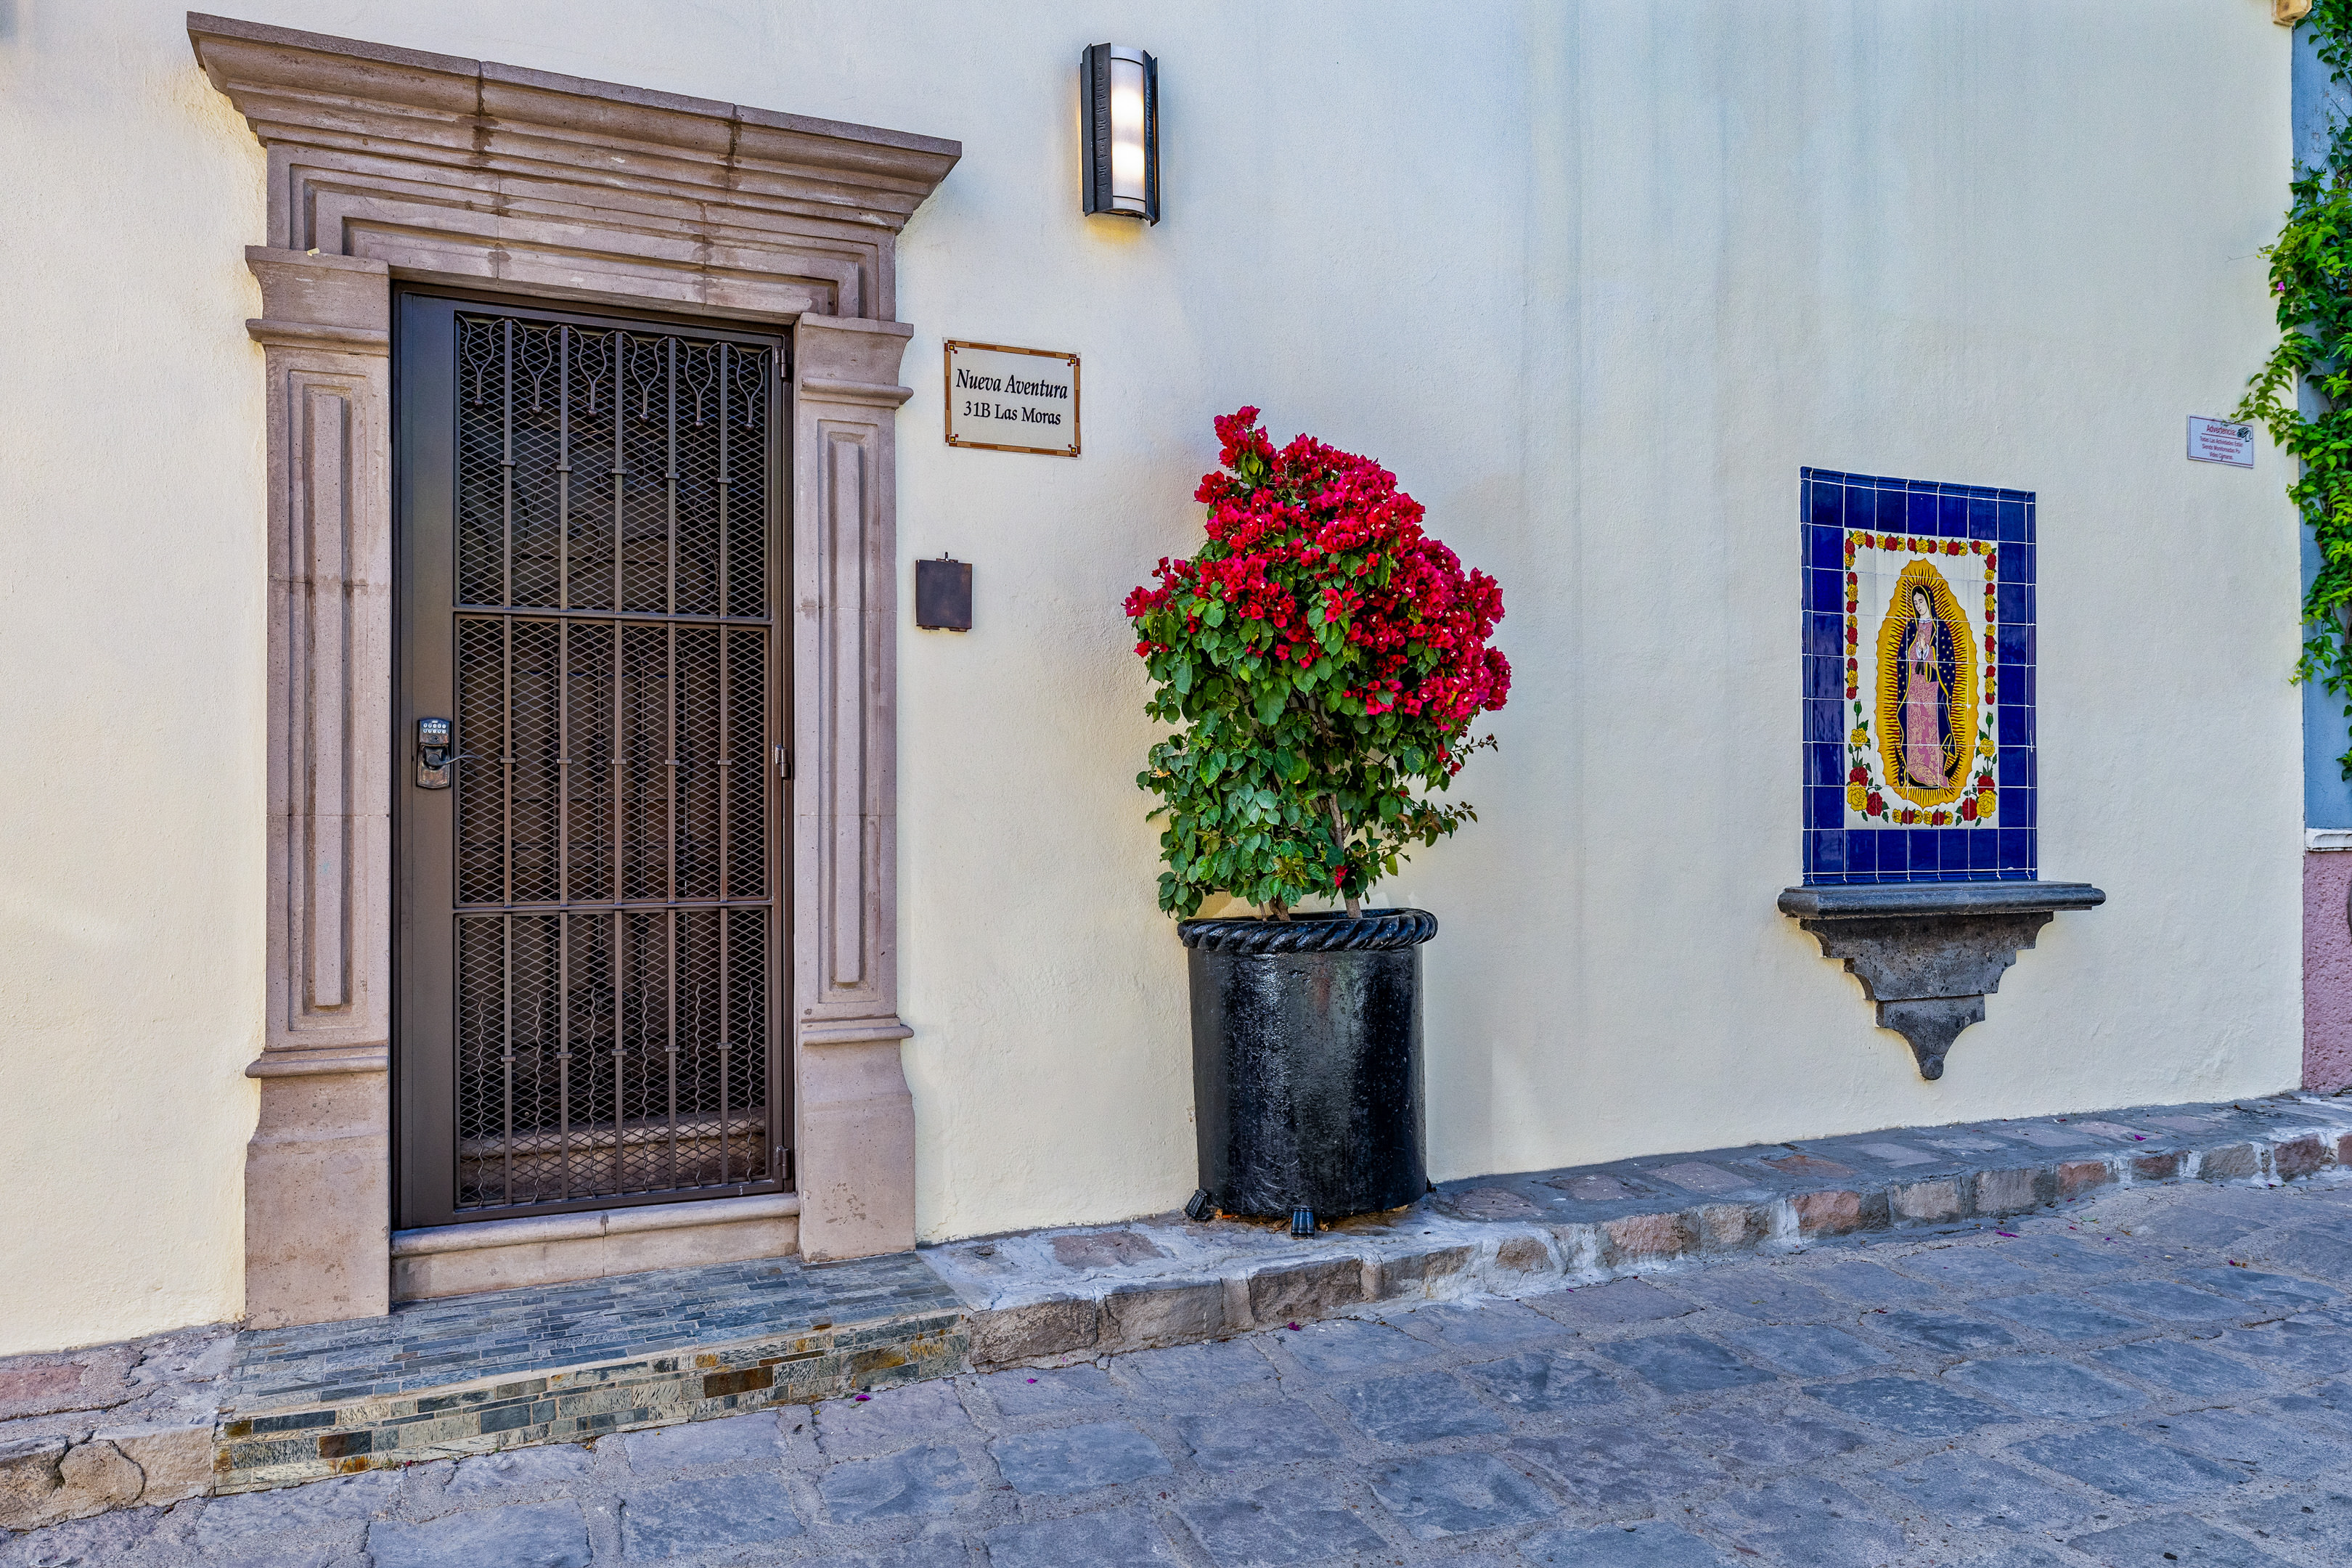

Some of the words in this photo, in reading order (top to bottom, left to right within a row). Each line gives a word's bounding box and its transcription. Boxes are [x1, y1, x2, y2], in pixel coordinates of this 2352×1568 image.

[955, 368, 1002, 392] Nueva
[1004, 374, 1068, 399] Aventura
[963, 401, 991, 418] 31B
[994, 404, 1018, 420] Las
[1021, 407, 1061, 425] Moras
